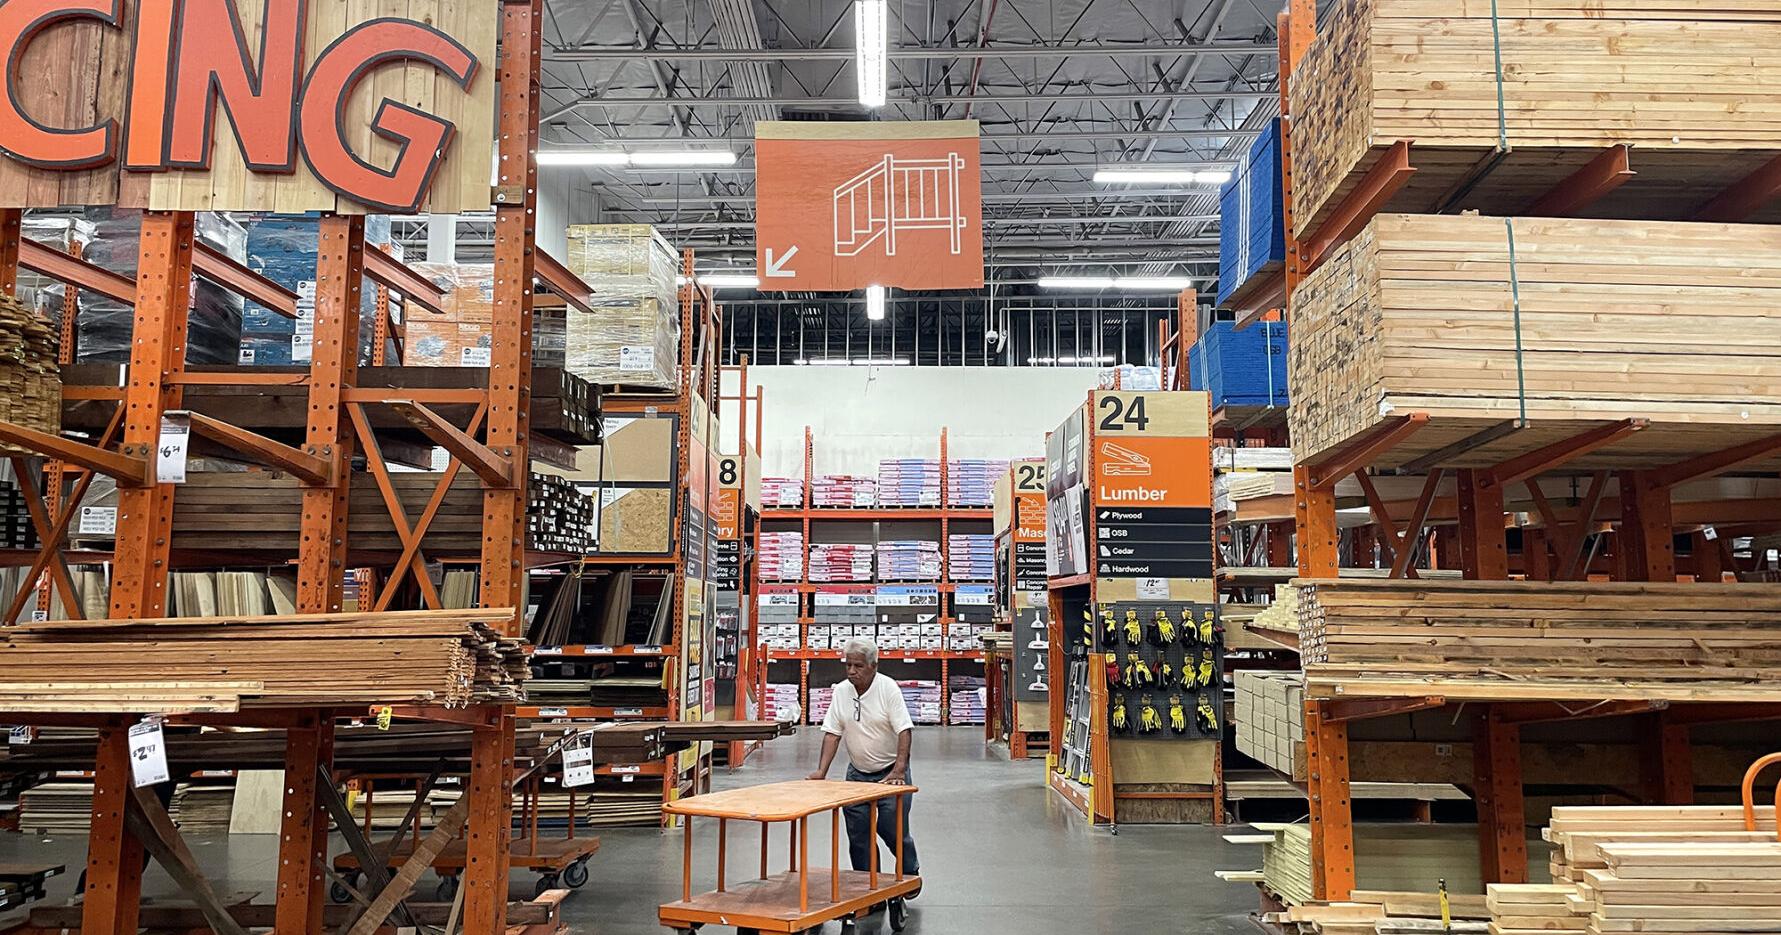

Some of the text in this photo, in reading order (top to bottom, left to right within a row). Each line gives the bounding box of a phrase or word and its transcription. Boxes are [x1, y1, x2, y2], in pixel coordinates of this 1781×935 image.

[1099, 396, 1149, 431] 24
[1018, 465, 1045, 490] 25
[1101, 485, 1168, 501] Lumber
[1111, 511, 1143, 521] Plywood
[1111, 529, 1129, 537] OSB
[1112, 547, 1135, 555] Cedar
[1112, 565, 1150, 574] Hardwood
